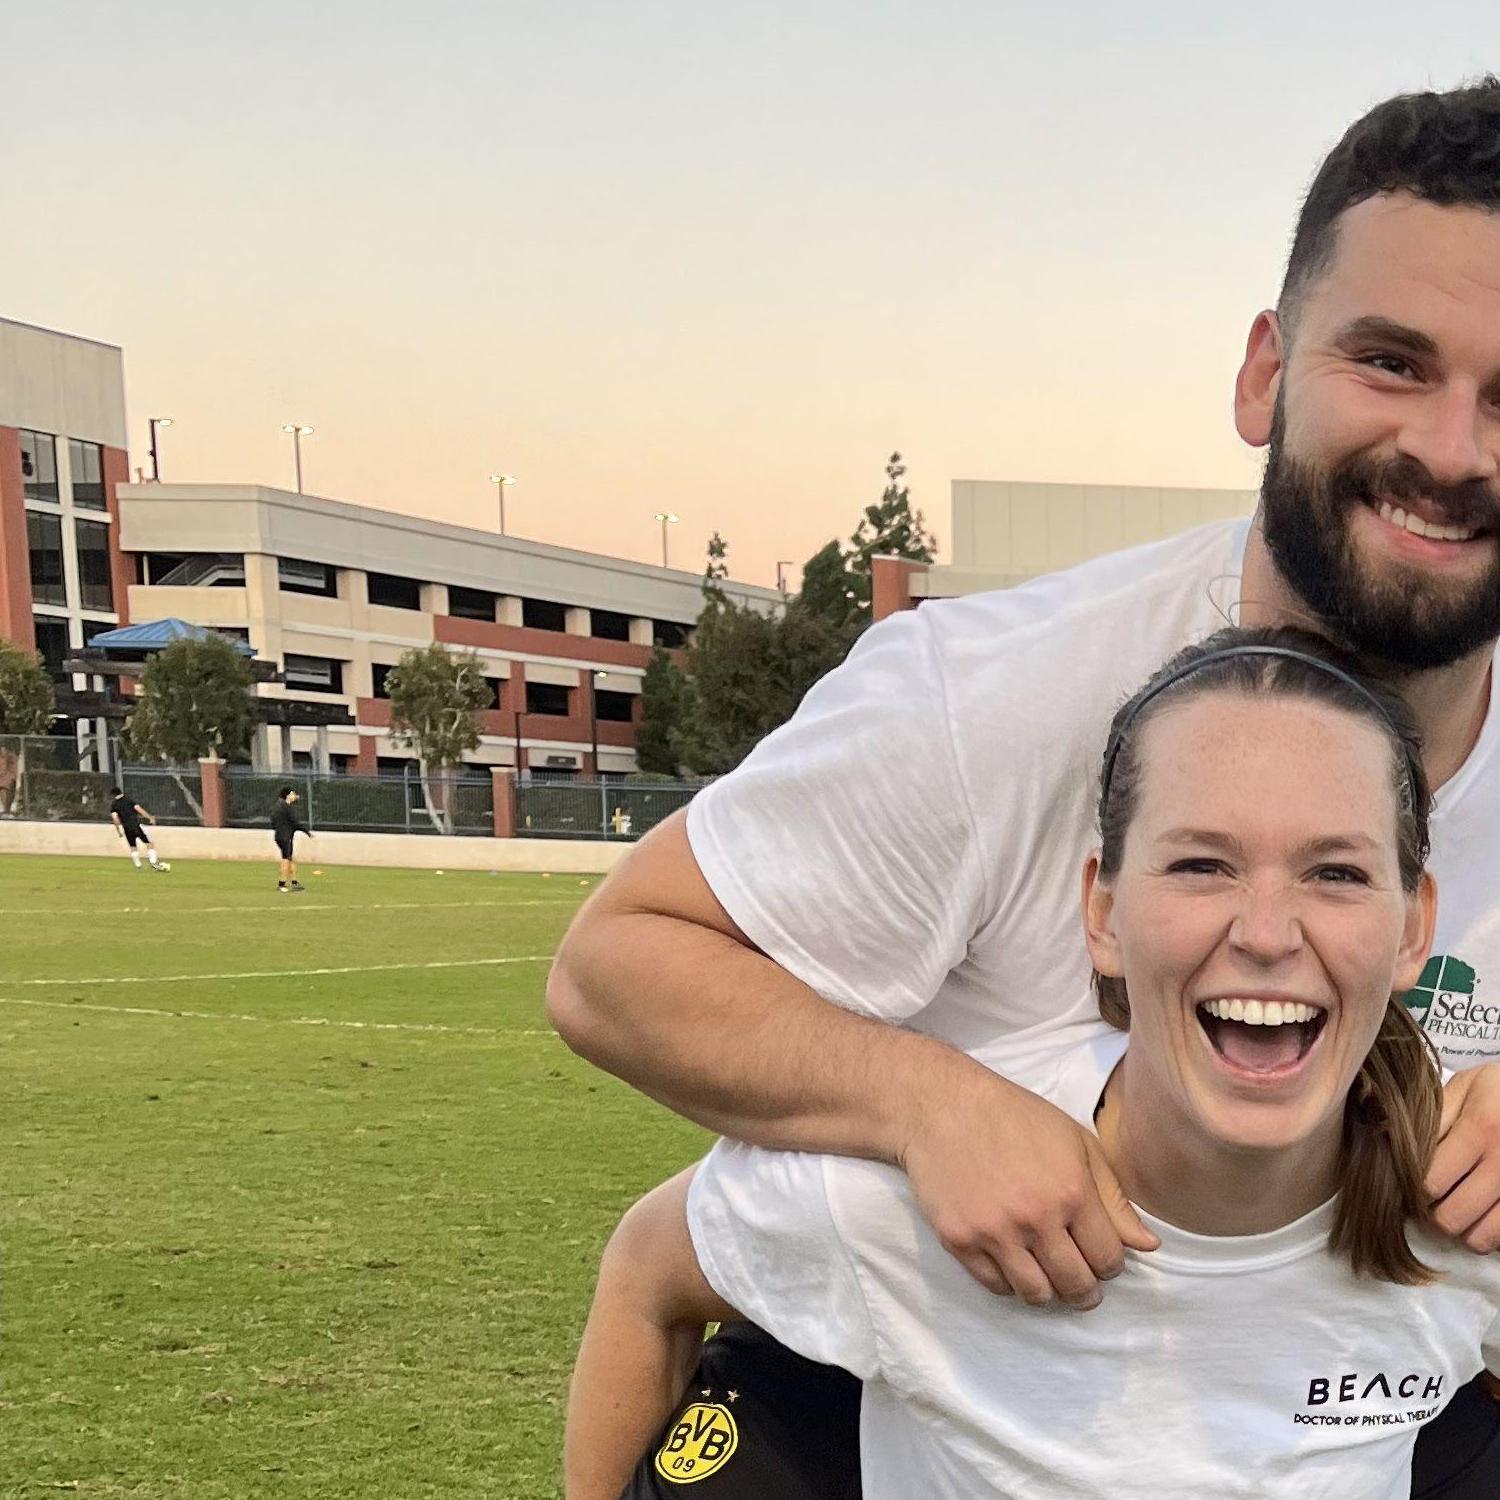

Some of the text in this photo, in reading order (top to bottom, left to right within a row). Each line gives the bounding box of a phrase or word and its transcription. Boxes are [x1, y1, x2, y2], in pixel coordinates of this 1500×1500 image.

[1427, 1019, 1490, 1040] PHYSICAL
[1307, 1373, 1444, 1406] BEACH
[1294, 1413, 1341, 1425] DOCTOR
[1344, 1416, 1360, 1425] OF
[1361, 1413, 1405, 1426] PHYSICAL
[665, 1409, 730, 1461] BVB
[672, 1456, 696, 1472] 09
